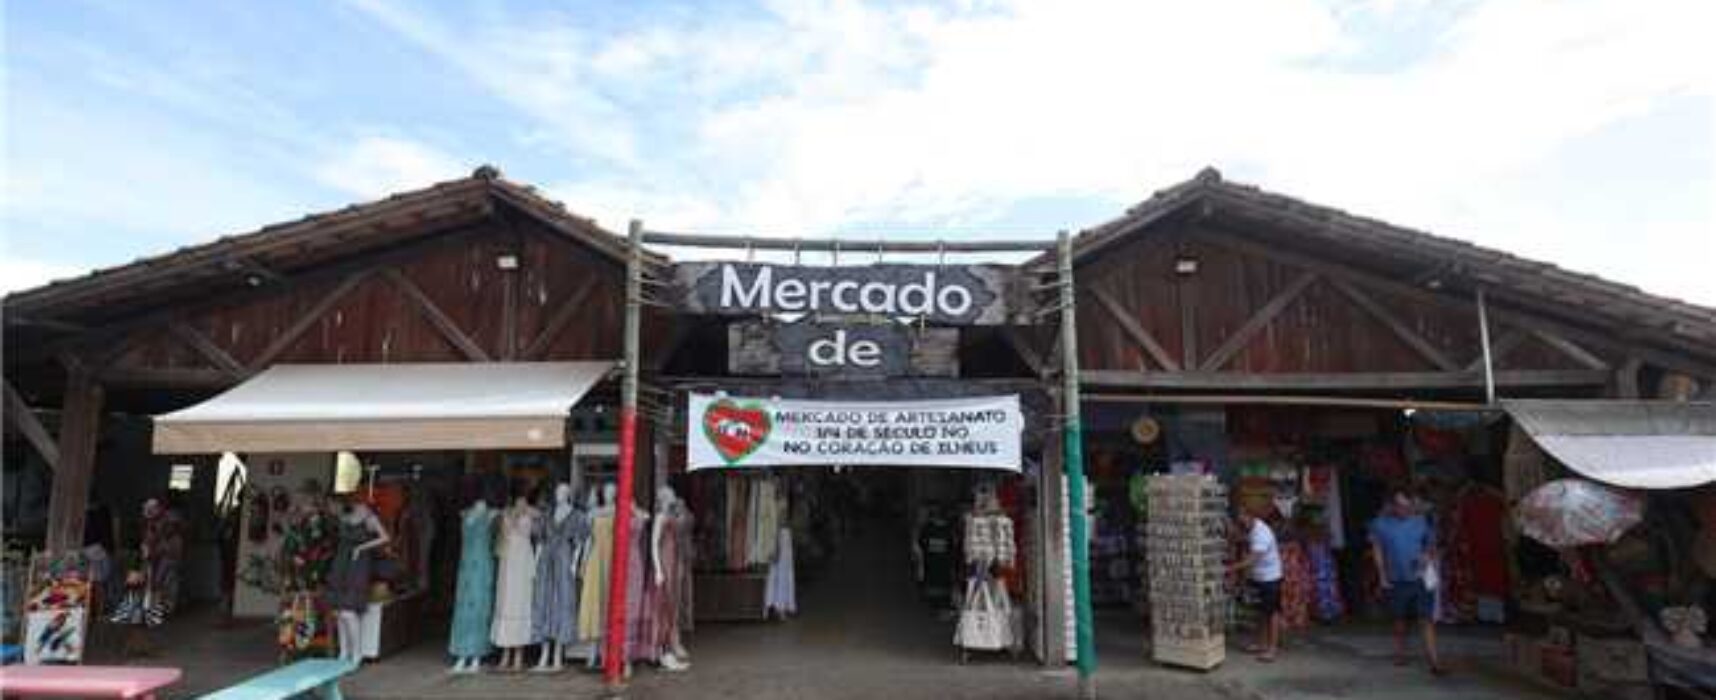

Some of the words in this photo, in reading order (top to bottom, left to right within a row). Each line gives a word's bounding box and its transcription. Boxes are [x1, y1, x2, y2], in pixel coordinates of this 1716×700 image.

[720, 264, 972, 316] Mercado
[809, 329, 881, 366] de
[775, 411, 861, 424] MERCADO
[868, 411, 888, 424] DE
[895, 410, 1007, 424] ARTESANATO
[847, 427, 867, 440] DE
[942, 426, 970, 440] NO
[783, 440, 812, 454] NO
[910, 441, 931, 455] DE
